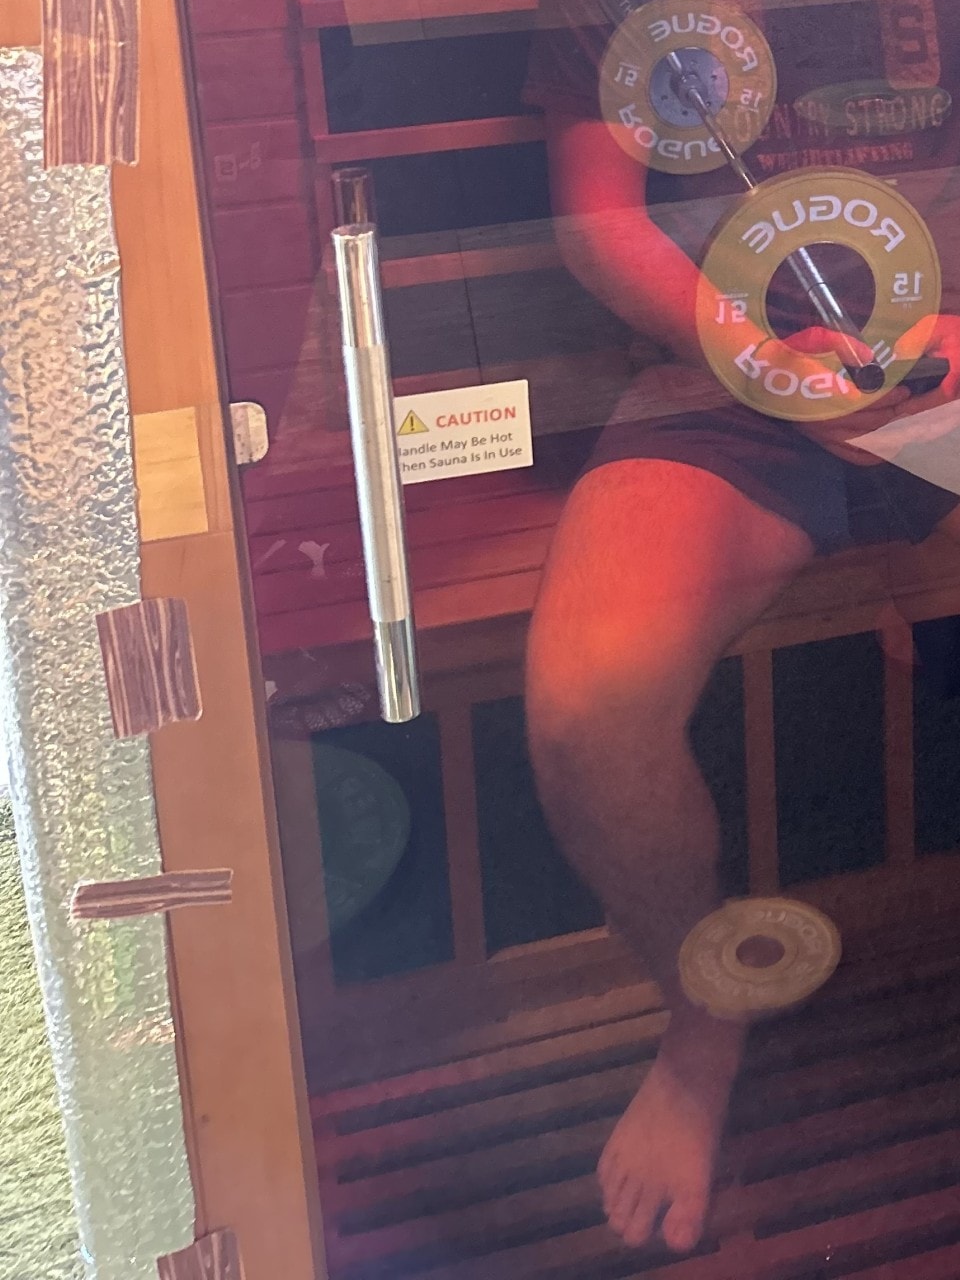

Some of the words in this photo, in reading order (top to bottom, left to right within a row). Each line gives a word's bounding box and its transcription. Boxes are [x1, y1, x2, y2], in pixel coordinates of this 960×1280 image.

[435, 406, 517, 429] CAUTION
[440, 439, 468, 451] May
[471, 436, 487, 447] Be
[490, 432, 513, 443] Hot
[401, 460, 426, 472] hen
[429, 455, 468, 468] Sauna
[471, 451, 481, 462] Is
[484, 449, 496, 460] In
[499, 446, 523, 458] Use
